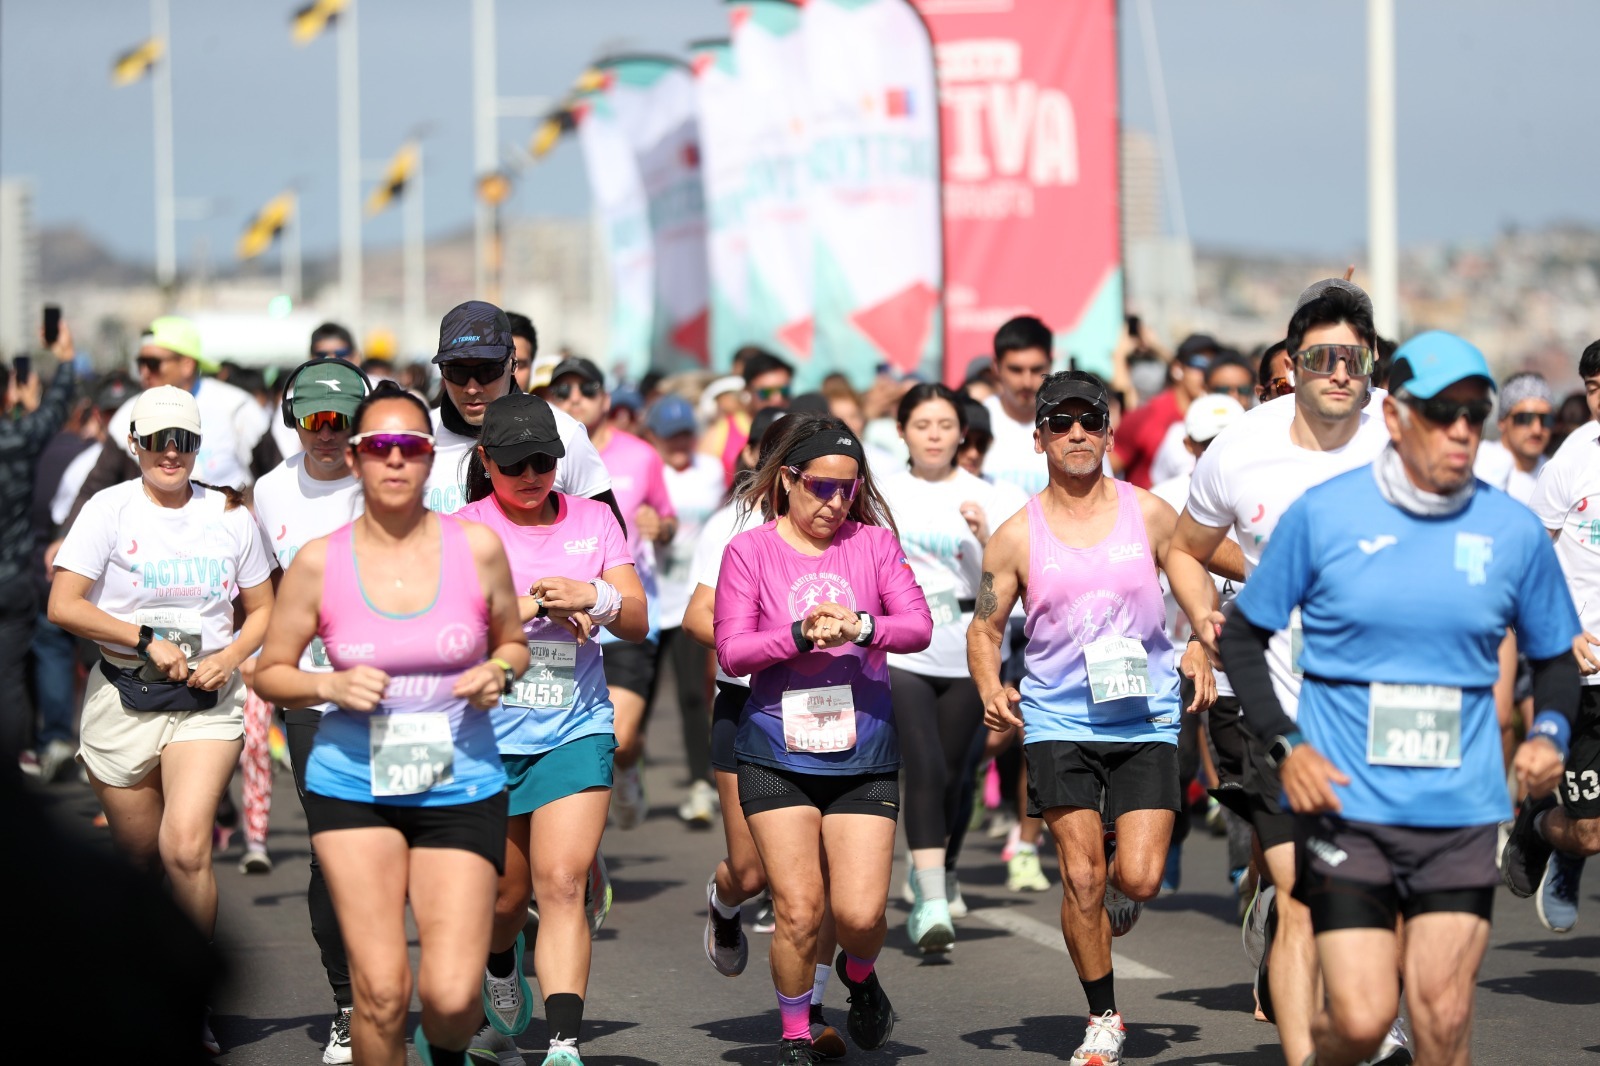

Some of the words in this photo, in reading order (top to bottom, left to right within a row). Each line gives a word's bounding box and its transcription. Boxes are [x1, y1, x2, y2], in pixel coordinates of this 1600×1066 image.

[143, 556, 221, 589] ACTIVA
[790, 572, 818, 592] MASTERS
[819, 572, 849, 589] RUNNERS
[168, 631, 181, 641] 5K
[540, 670, 554, 681] 5K
[1121, 660, 1133, 671] 5K
[514, 682, 563, 706] 1453
[1103, 673, 1147, 698] 2037
[1416, 711, 1437, 730] 5K
[411, 745, 430, 761] 5K
[1386, 727, 1450, 761] 2047
[1565, 769, 1600, 802] 53
